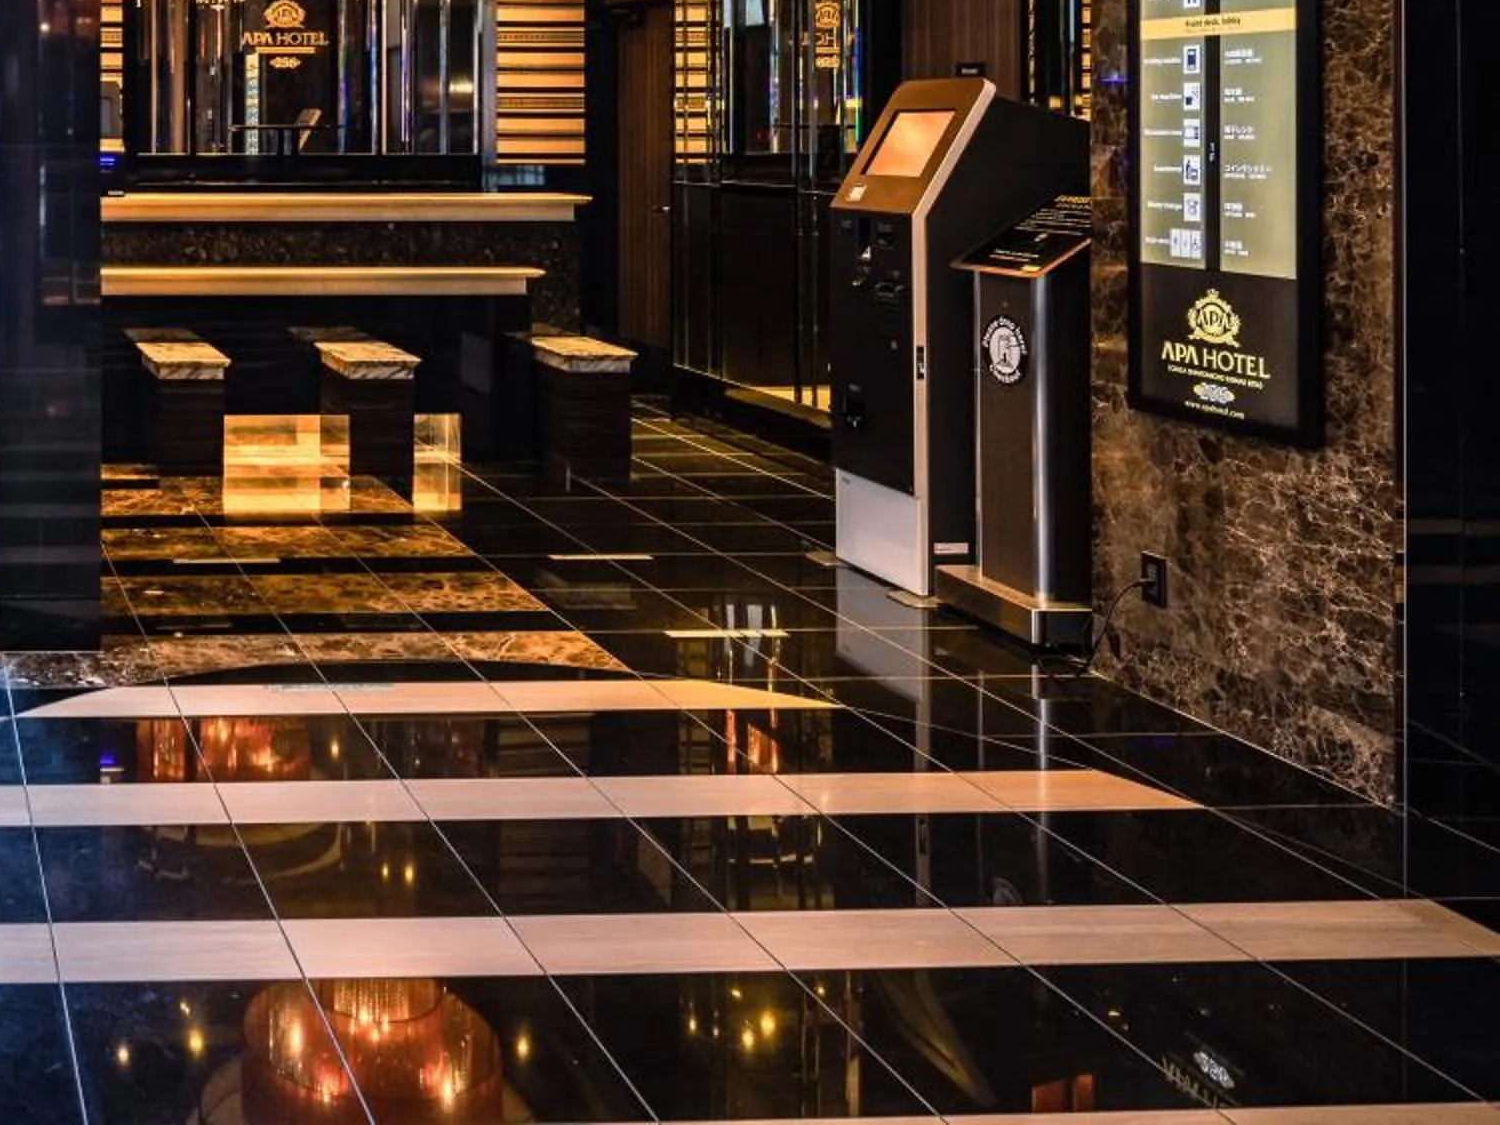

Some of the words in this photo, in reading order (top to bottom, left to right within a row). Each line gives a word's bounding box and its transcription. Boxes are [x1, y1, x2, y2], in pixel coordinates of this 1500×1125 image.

[243, 32, 274, 46] APA
[276, 32, 329, 46] HOTEL
[1197, 308, 1230, 329] APA
[1162, 340, 1199, 366] APA
[1202, 348, 1271, 379] HOTEL
